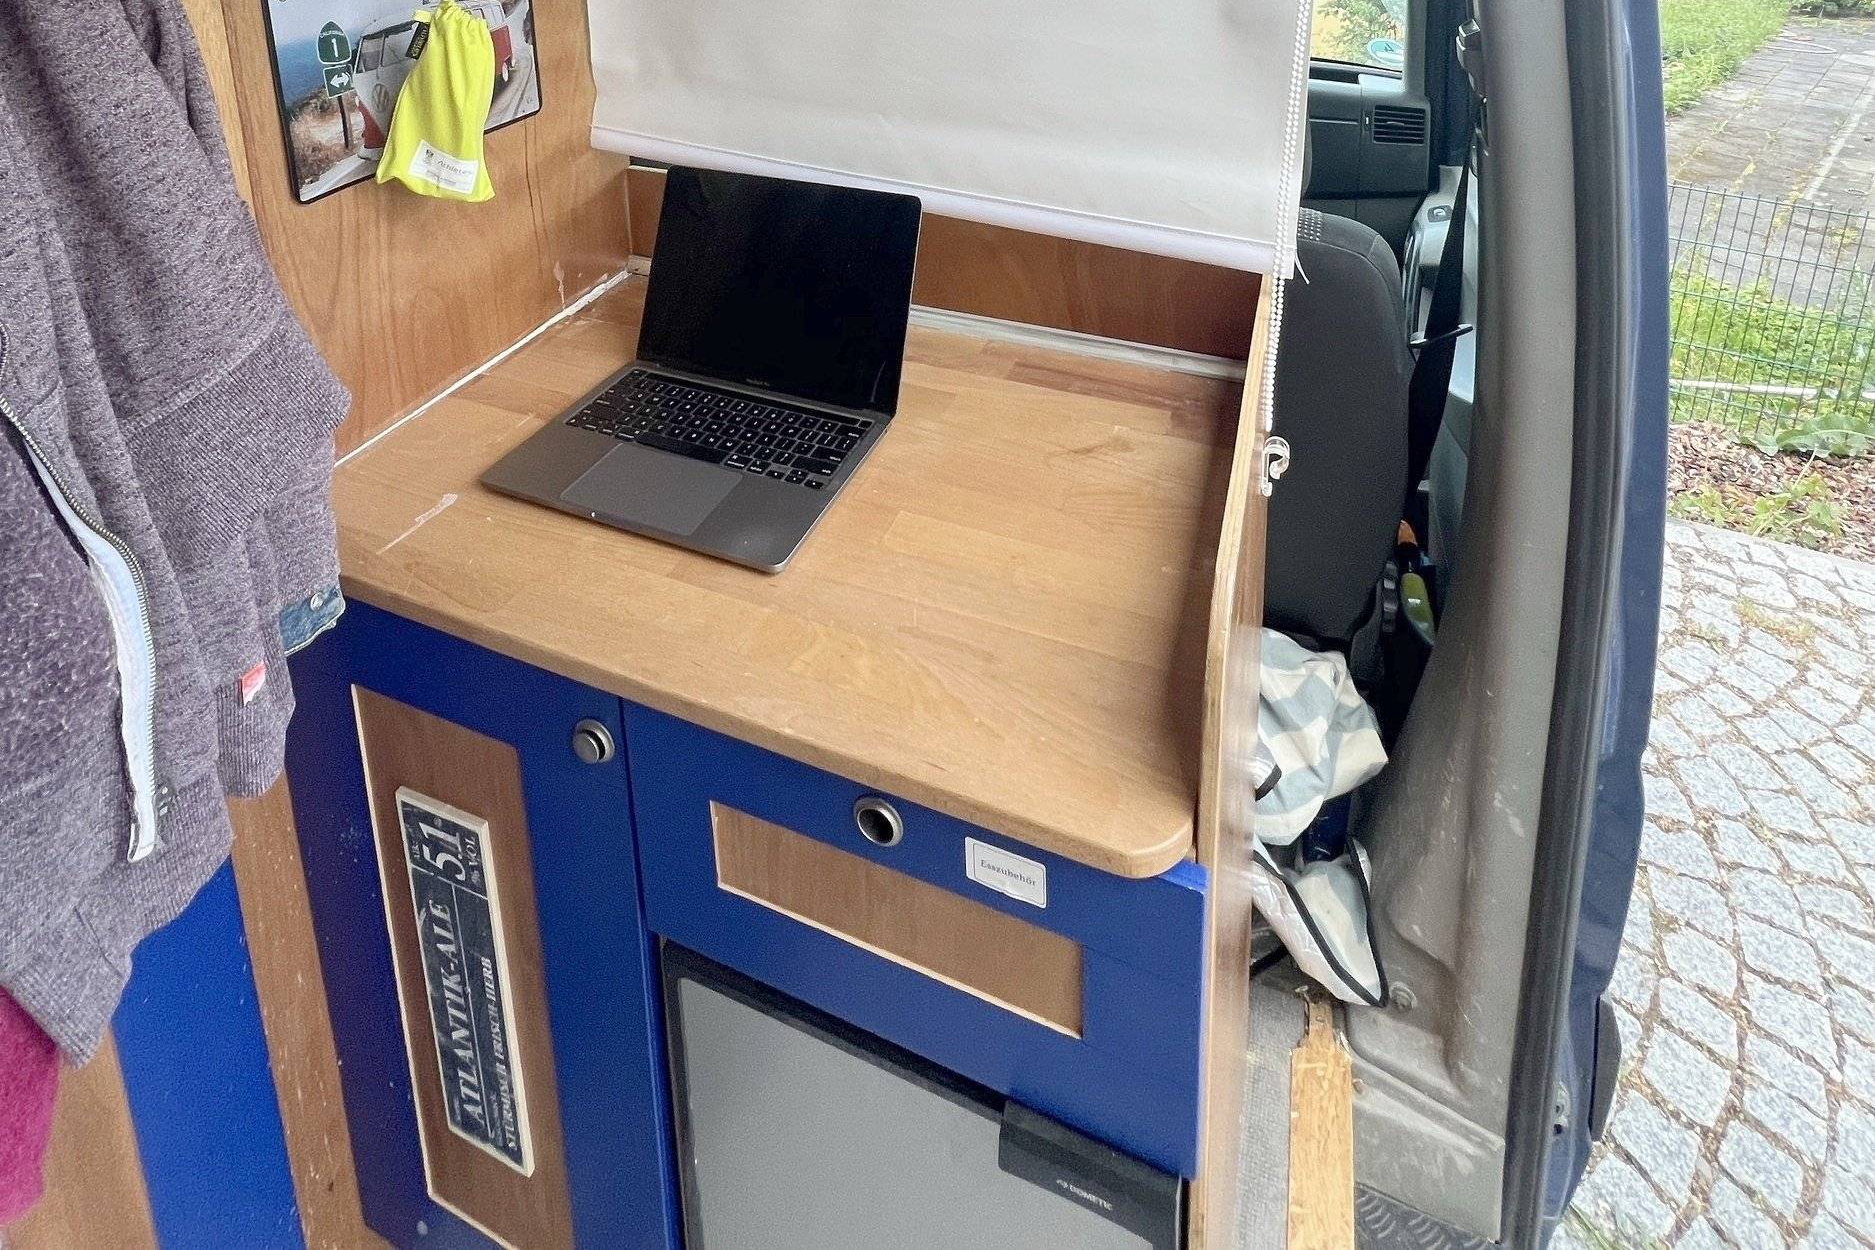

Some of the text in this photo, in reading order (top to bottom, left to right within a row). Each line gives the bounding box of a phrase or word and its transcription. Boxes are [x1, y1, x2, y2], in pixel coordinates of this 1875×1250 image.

[331, 37, 339, 58] 1
[418, 821, 467, 882] 5.1
[429, 898, 486, 1128] ATLANTIK-ALE
